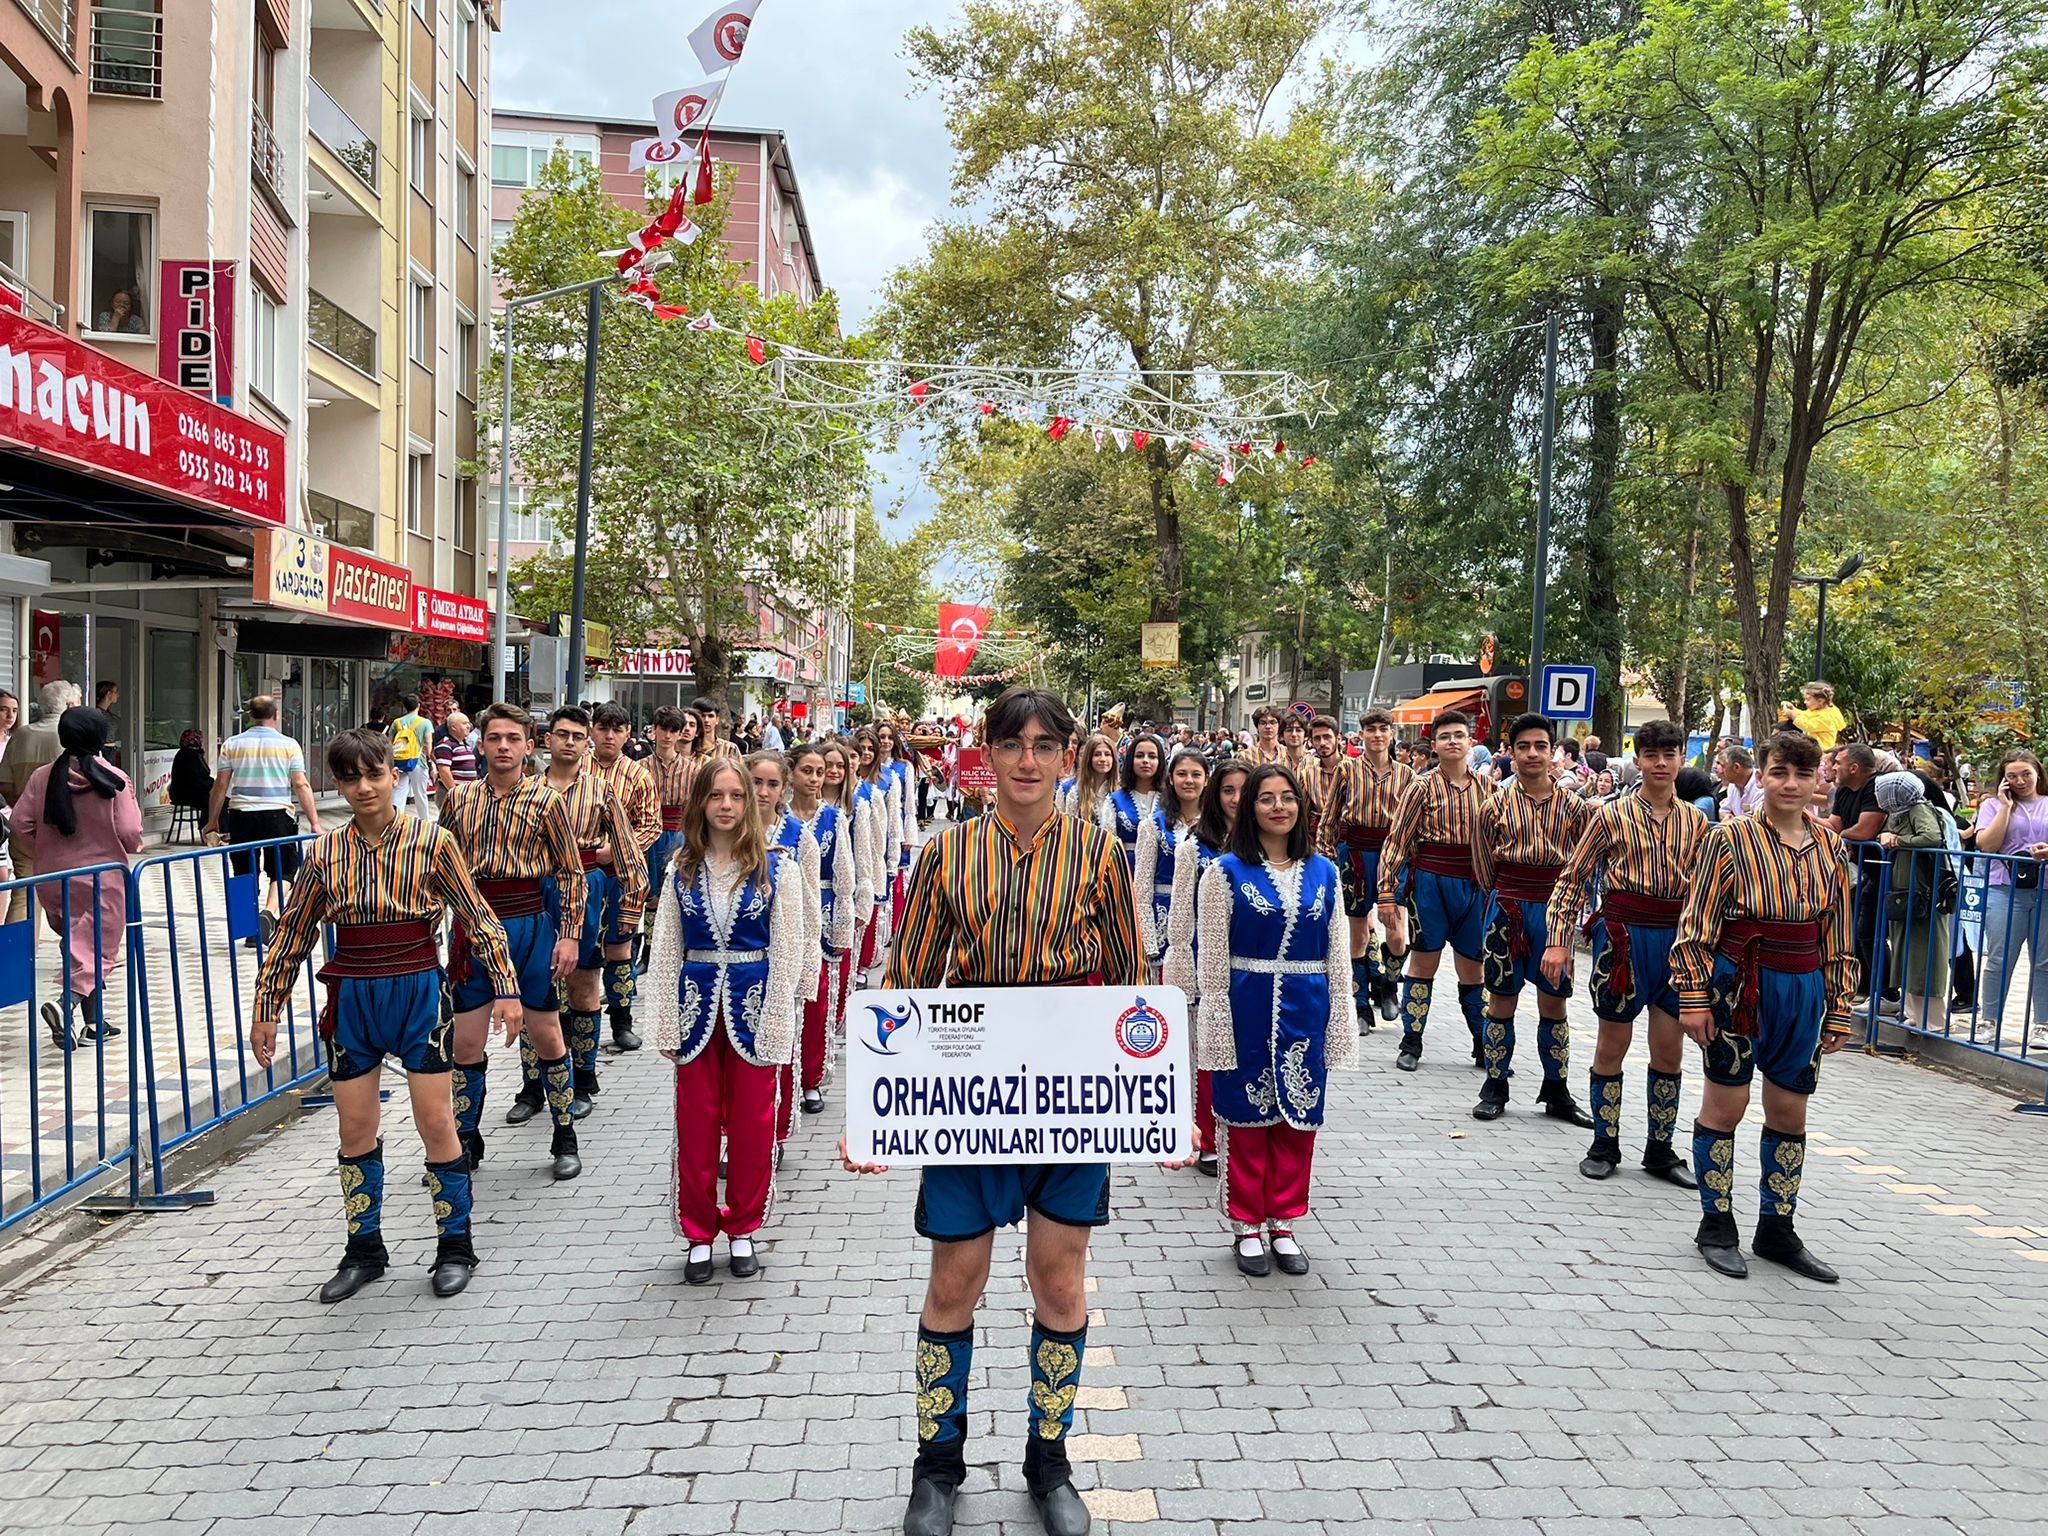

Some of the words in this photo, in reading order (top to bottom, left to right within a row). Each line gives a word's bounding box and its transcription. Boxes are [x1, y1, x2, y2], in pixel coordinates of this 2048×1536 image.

[178, 413, 210, 445] 0266
[214, 427, 235, 456] 865
[240, 438, 253, 463] 33
[256, 445, 270, 470] 93
[178, 449, 210, 481] 0535
[214, 462, 235, 489] 528
[239, 471, 253, 495] 24
[256, 479, 269, 501] 91
[296, 537, 306, 569] 3
[275, 569, 324, 604] KARDEŞLER
[331, 558, 409, 614] pastanesi
[430, 593, 457, 619] ÖMER
[457, 603, 485, 624] AYBAK
[1555, 677, 1581, 707] D
[927, 1003, 985, 1024] THOF
[872, 1064, 1028, 1118] ORHANGAZİ
[1035, 1063, 1176, 1116] BELEDİYESİ
[872, 1129, 929, 1156] HALK
[934, 1128, 1045, 1155] OYUNLARI
[1049, 1122, 1177, 1155] TOPLULUĞU
